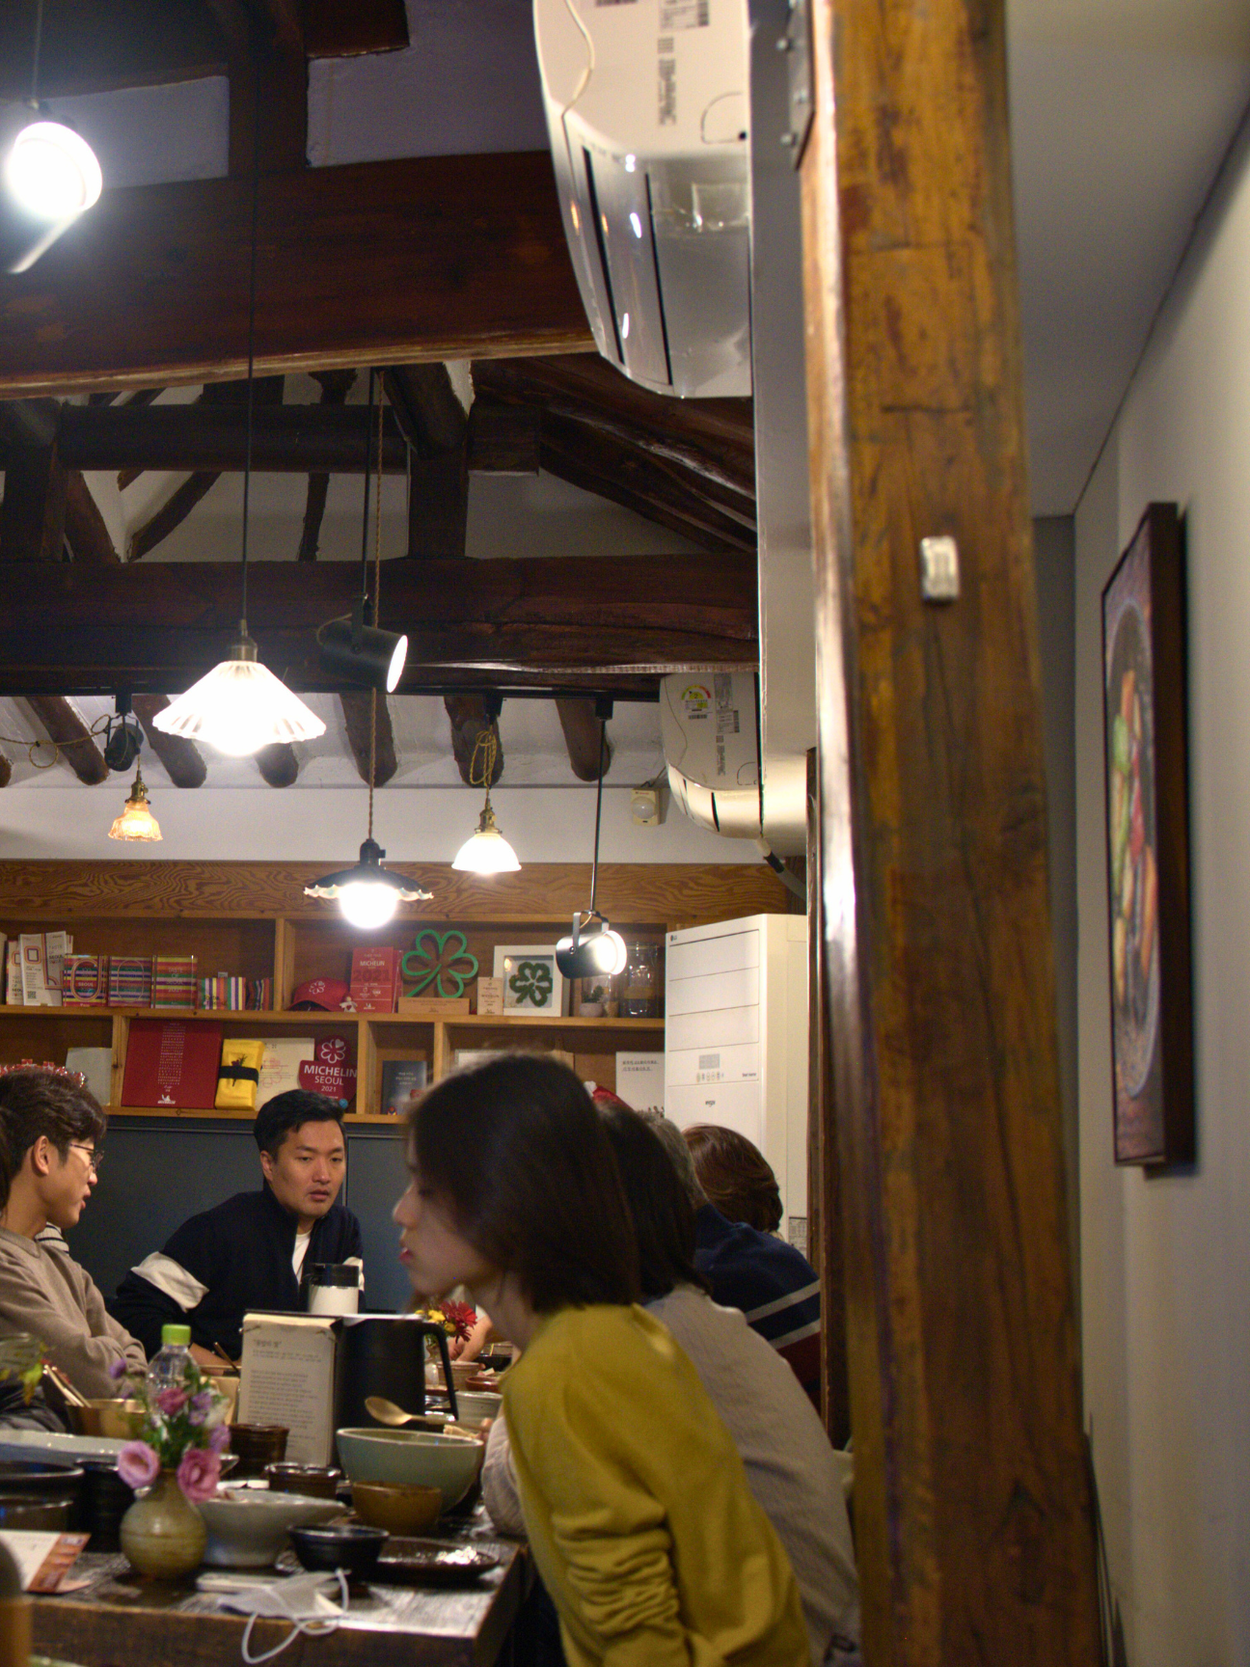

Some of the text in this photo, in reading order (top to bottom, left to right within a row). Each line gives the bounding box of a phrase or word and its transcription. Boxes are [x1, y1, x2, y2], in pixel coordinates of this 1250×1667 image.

[352, 969, 391, 982] 2021
[304, 1065, 357, 1078] MICHELIN
[314, 1075, 344, 1086] SEOUL
